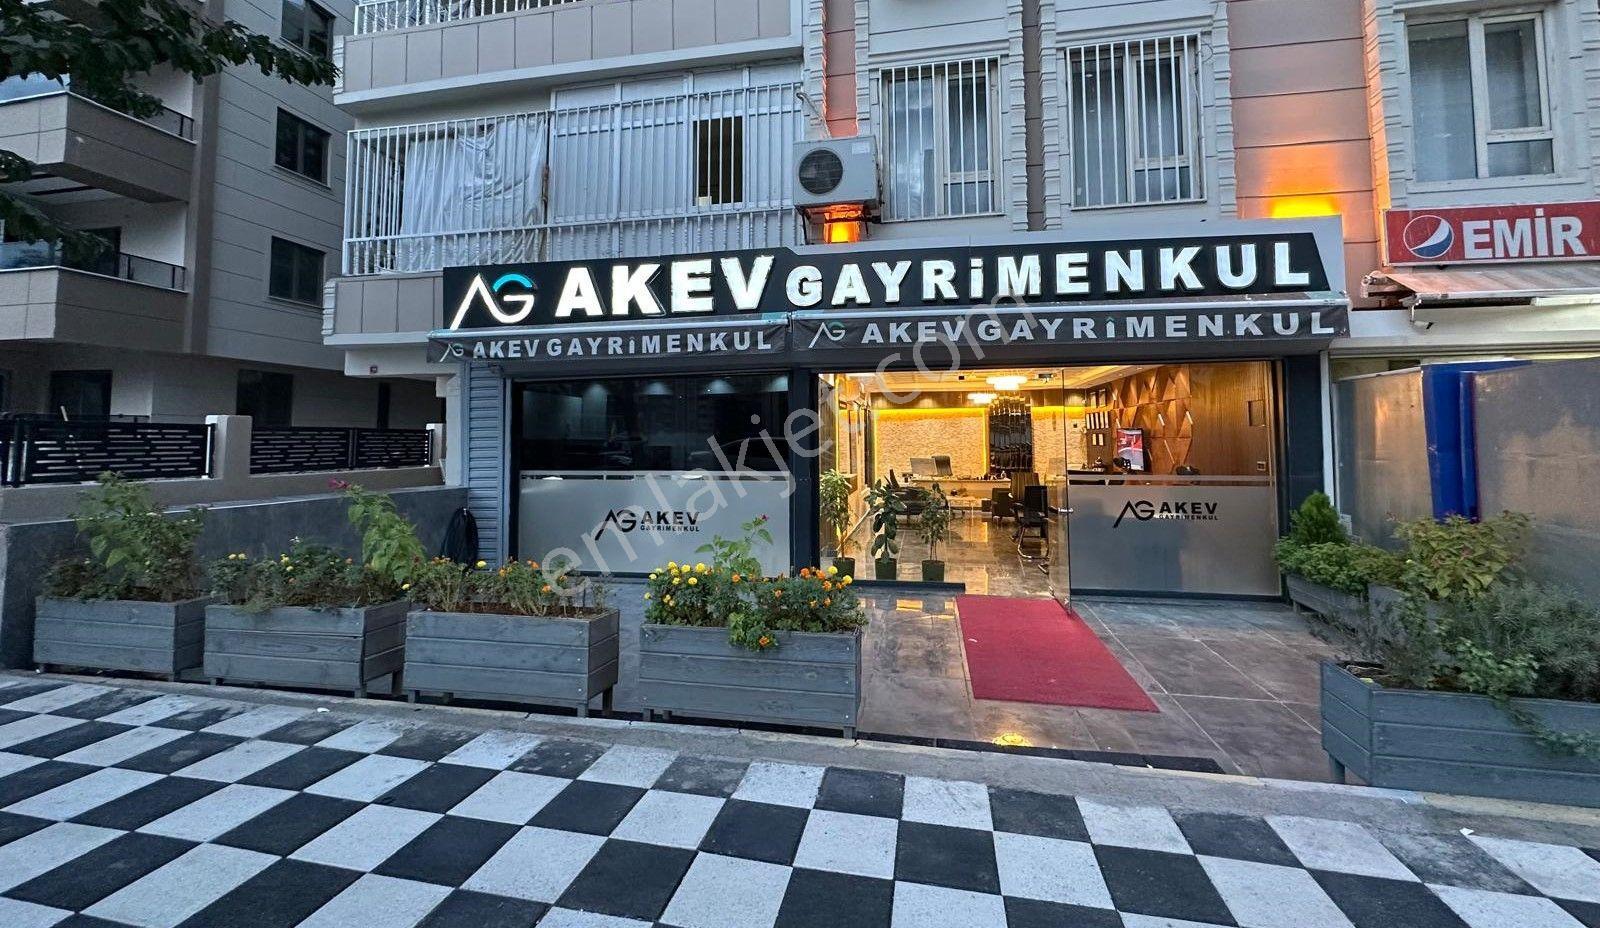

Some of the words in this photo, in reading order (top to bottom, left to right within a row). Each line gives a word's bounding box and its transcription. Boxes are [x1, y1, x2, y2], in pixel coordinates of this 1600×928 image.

[1462, 208, 1587, 260] EMİR
[554, 254, 777, 319] AKEV
[861, 318, 967, 344] AKEV
[473, 338, 540, 360] AKEV
[640, 511, 700, 525] AKEV
[1159, 501, 1218, 514] AKEV
